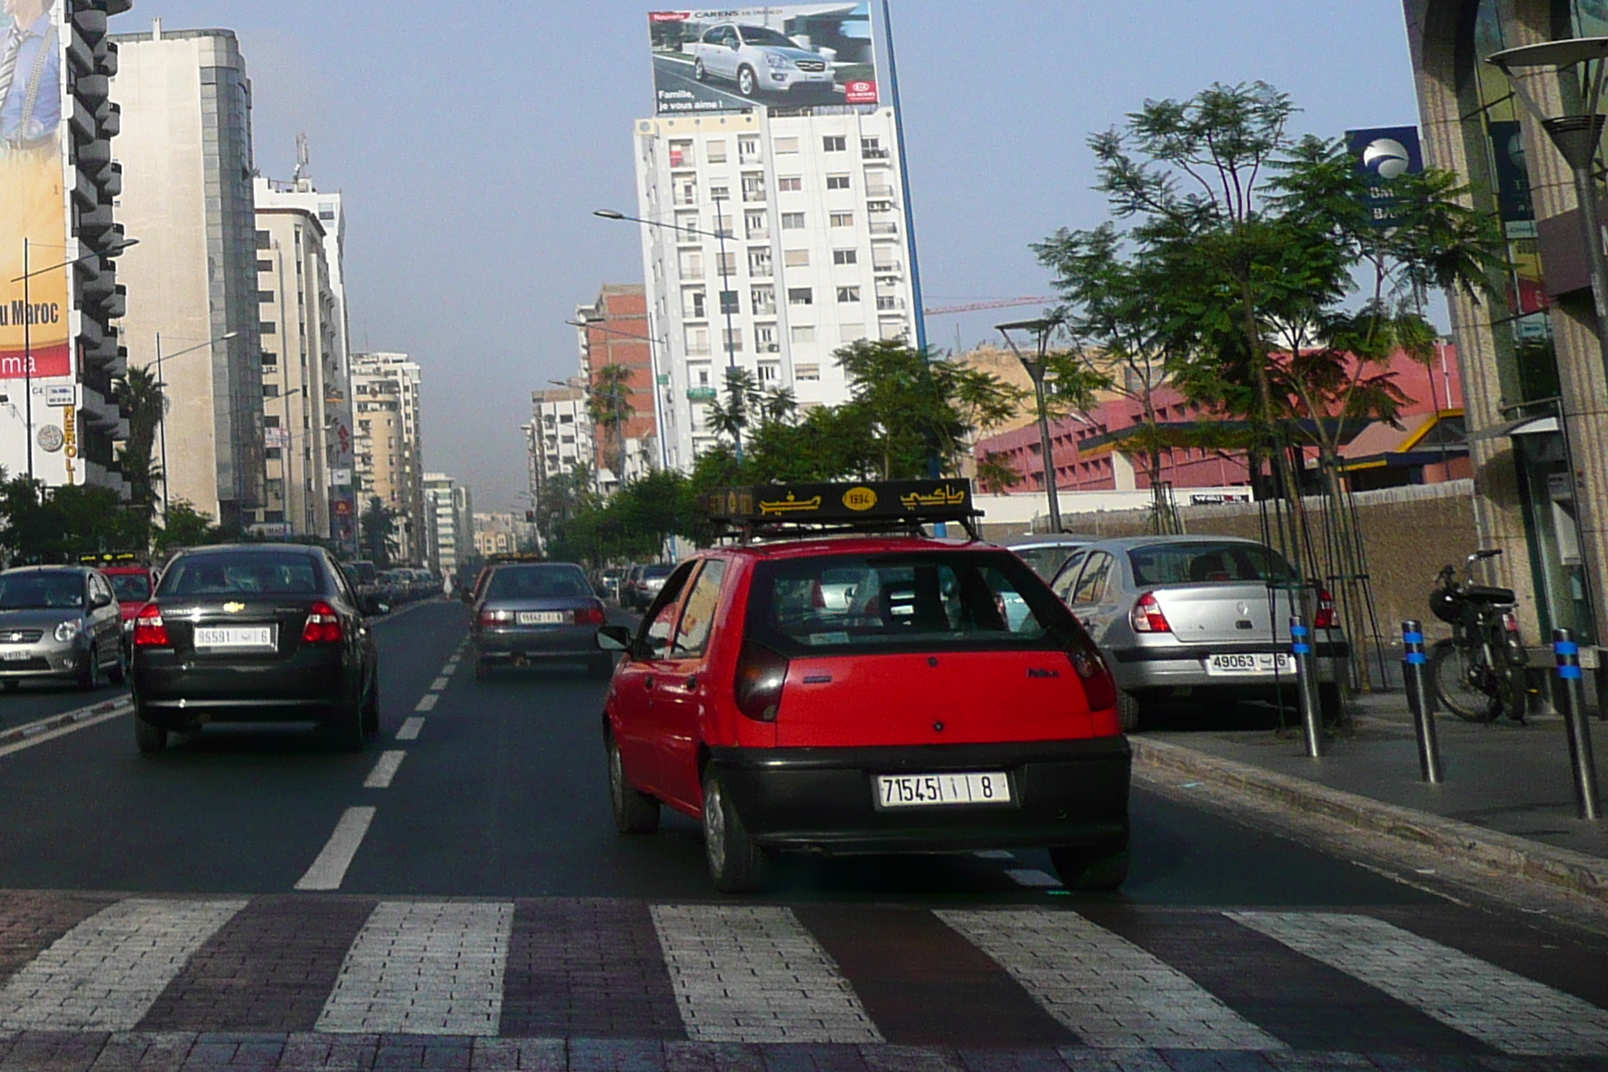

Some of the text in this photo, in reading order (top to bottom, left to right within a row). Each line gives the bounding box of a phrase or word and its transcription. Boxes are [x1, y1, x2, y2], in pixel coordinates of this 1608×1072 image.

[694, 11, 739, 19] CARENS
[659, 102, 668, 112] je
[670, 102, 692, 110] vous
[694, 101, 718, 109] aime
[11, 299, 59, 327] Maroc
[758, 491, 822, 516] صغير
[900, 483, 965, 511] طاكسي
[1214, 655, 1255, 668] 49063
[1277, 654, 1286, 666] 6
[882, 778, 938, 802] 71545
[981, 776, 993, 798] 8
